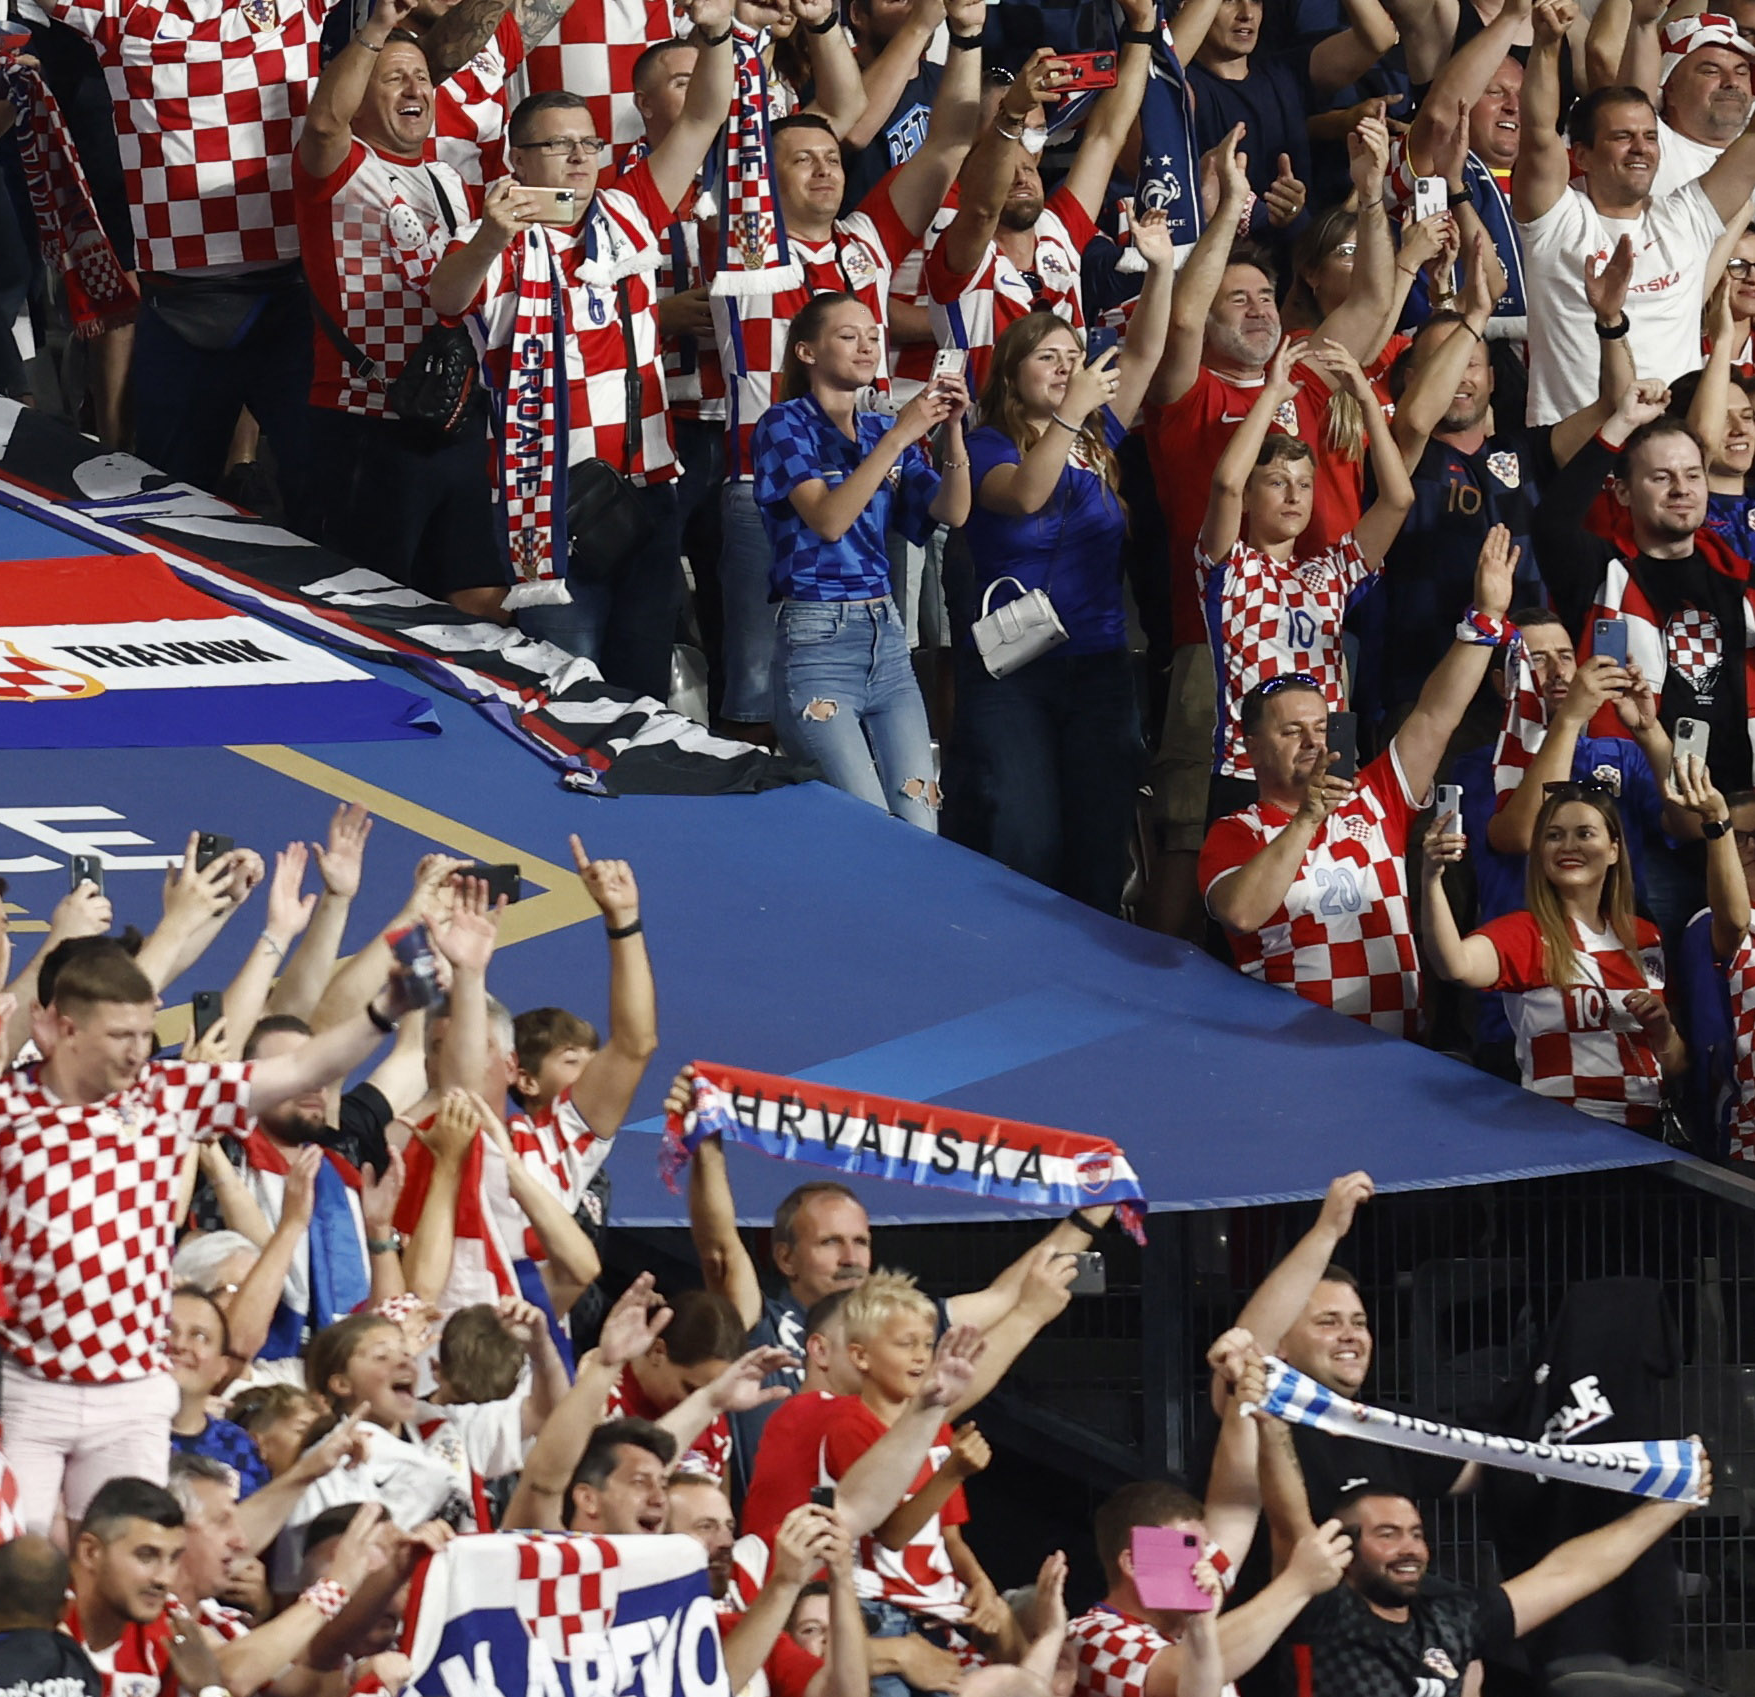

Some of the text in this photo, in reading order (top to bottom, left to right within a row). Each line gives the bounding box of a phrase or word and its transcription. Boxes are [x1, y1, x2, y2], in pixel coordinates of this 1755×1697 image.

[515, 337, 545, 497] CROATIE
[1448, 477, 1483, 516] 10
[1285, 606, 1317, 649] 10
[52, 639, 291, 669] TRAVNIK
[1315, 867, 1362, 916] 20
[1570, 986, 1605, 1029] 10
[730, 1085, 1052, 1190] HRVATSKA
